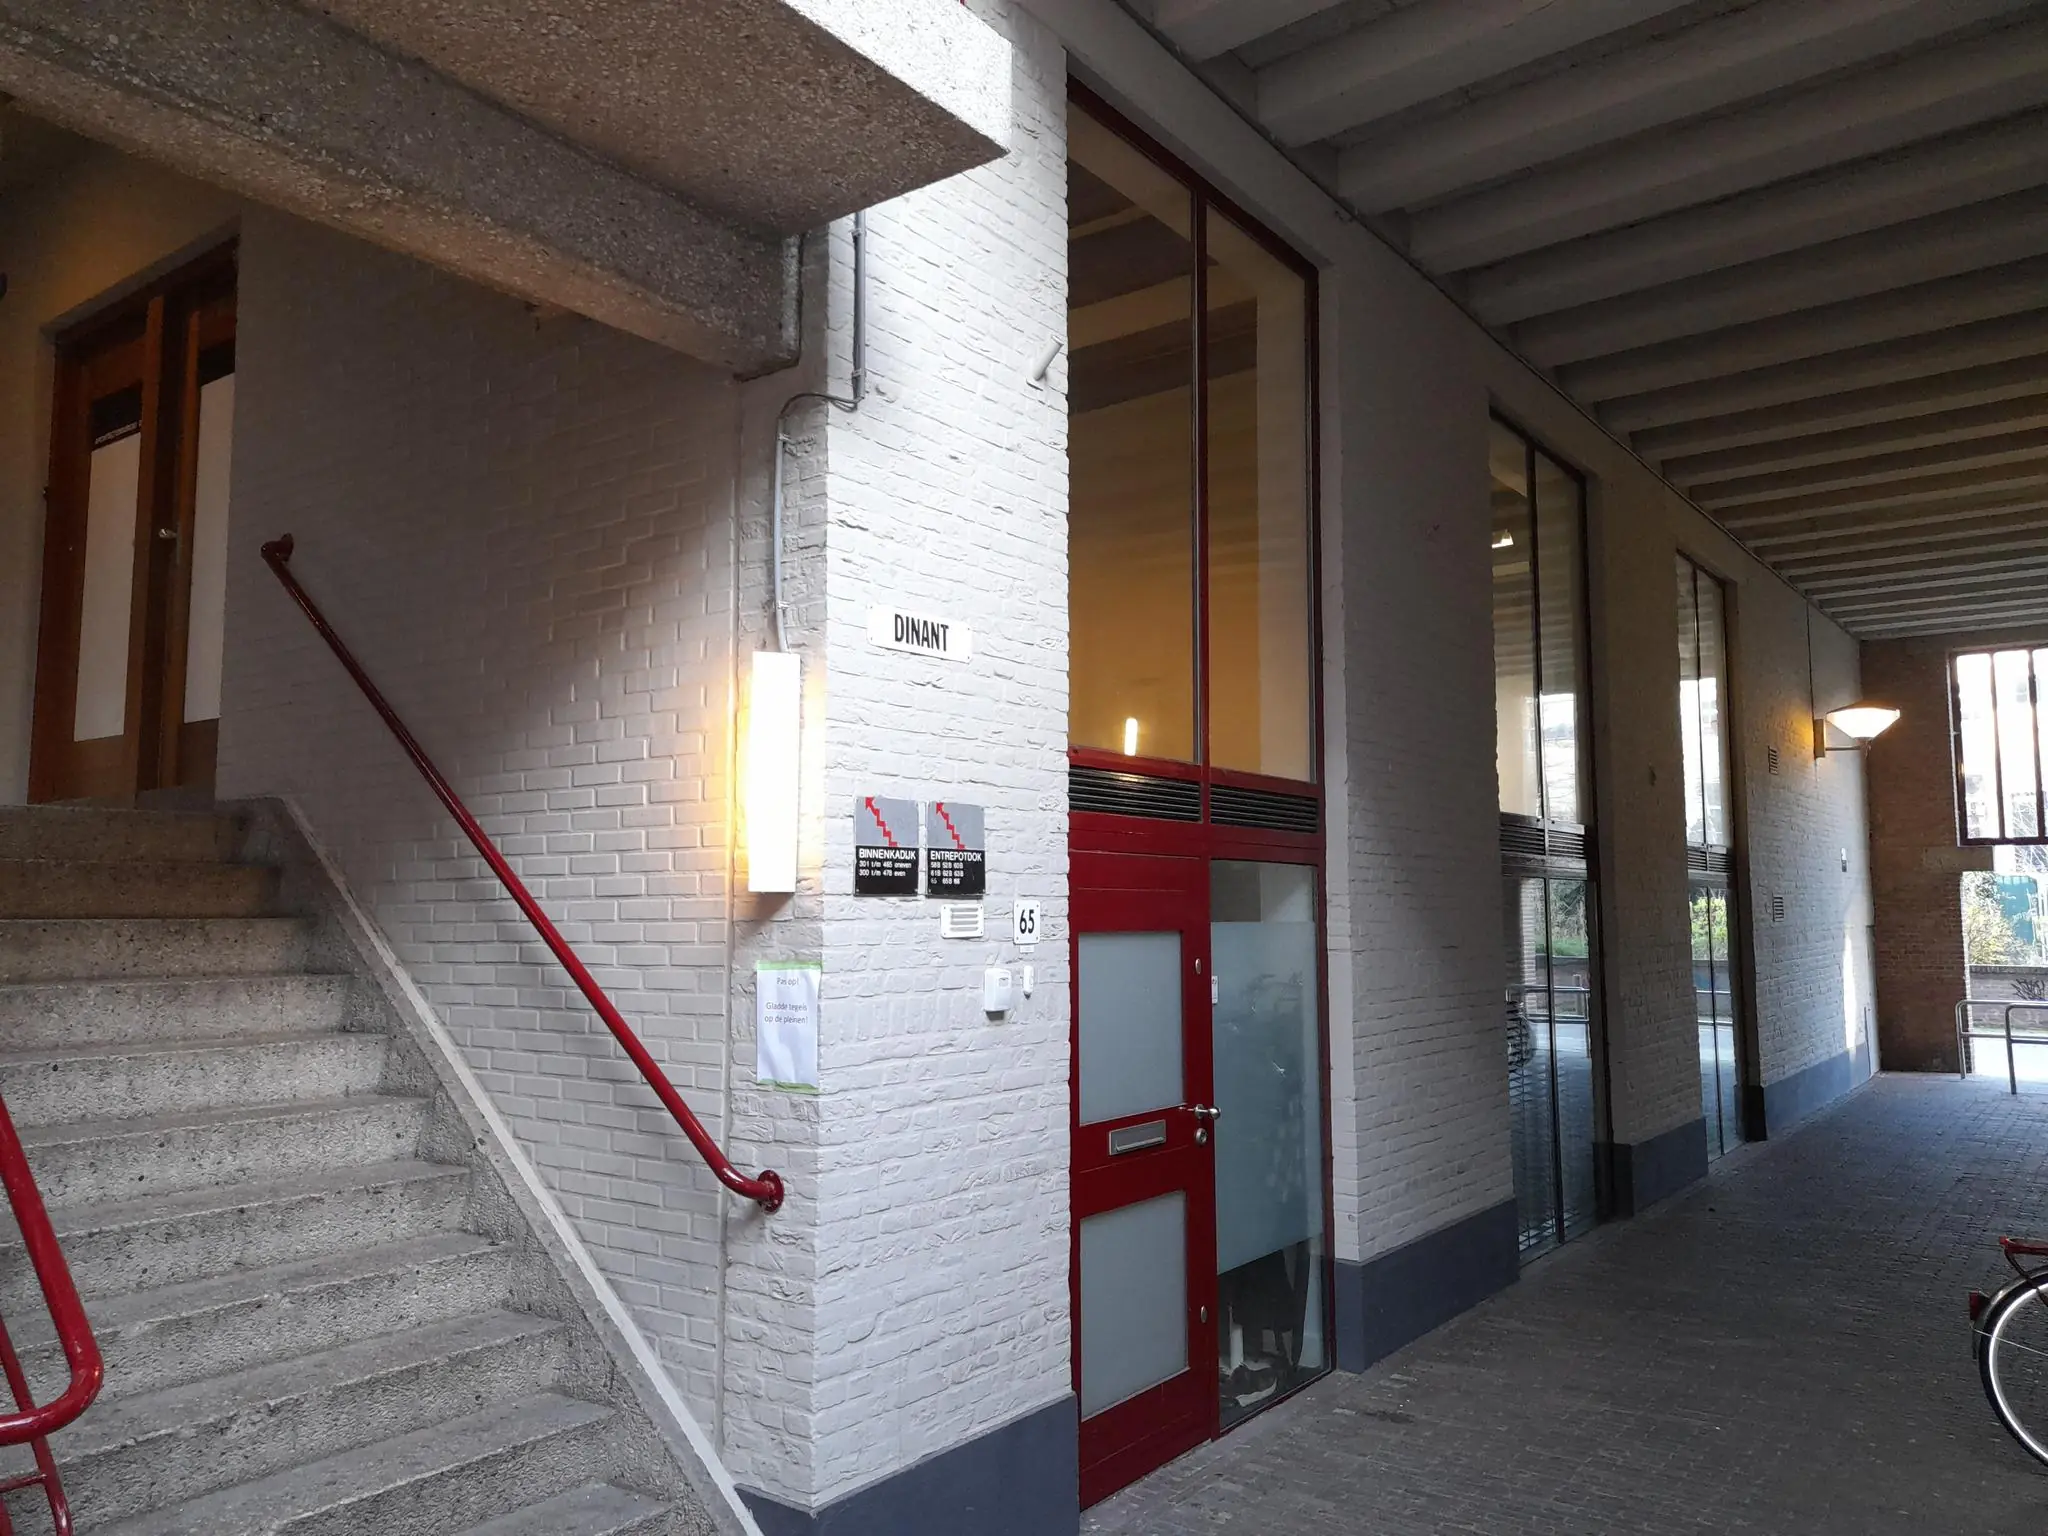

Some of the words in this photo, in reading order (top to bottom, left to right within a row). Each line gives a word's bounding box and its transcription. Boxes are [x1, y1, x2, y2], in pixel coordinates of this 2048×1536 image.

[894, 613, 949, 652] DINANT
[859, 848, 916, 860] BINNENKADIJK
[930, 851, 982, 862] ENTREPOTDOK
[1020, 909, 1034, 934] 65
[766, 1002, 788, 1010] Gladde
[789, 1003, 808, 1012] tegels
[784, 1016, 808, 1024] pleinen!
